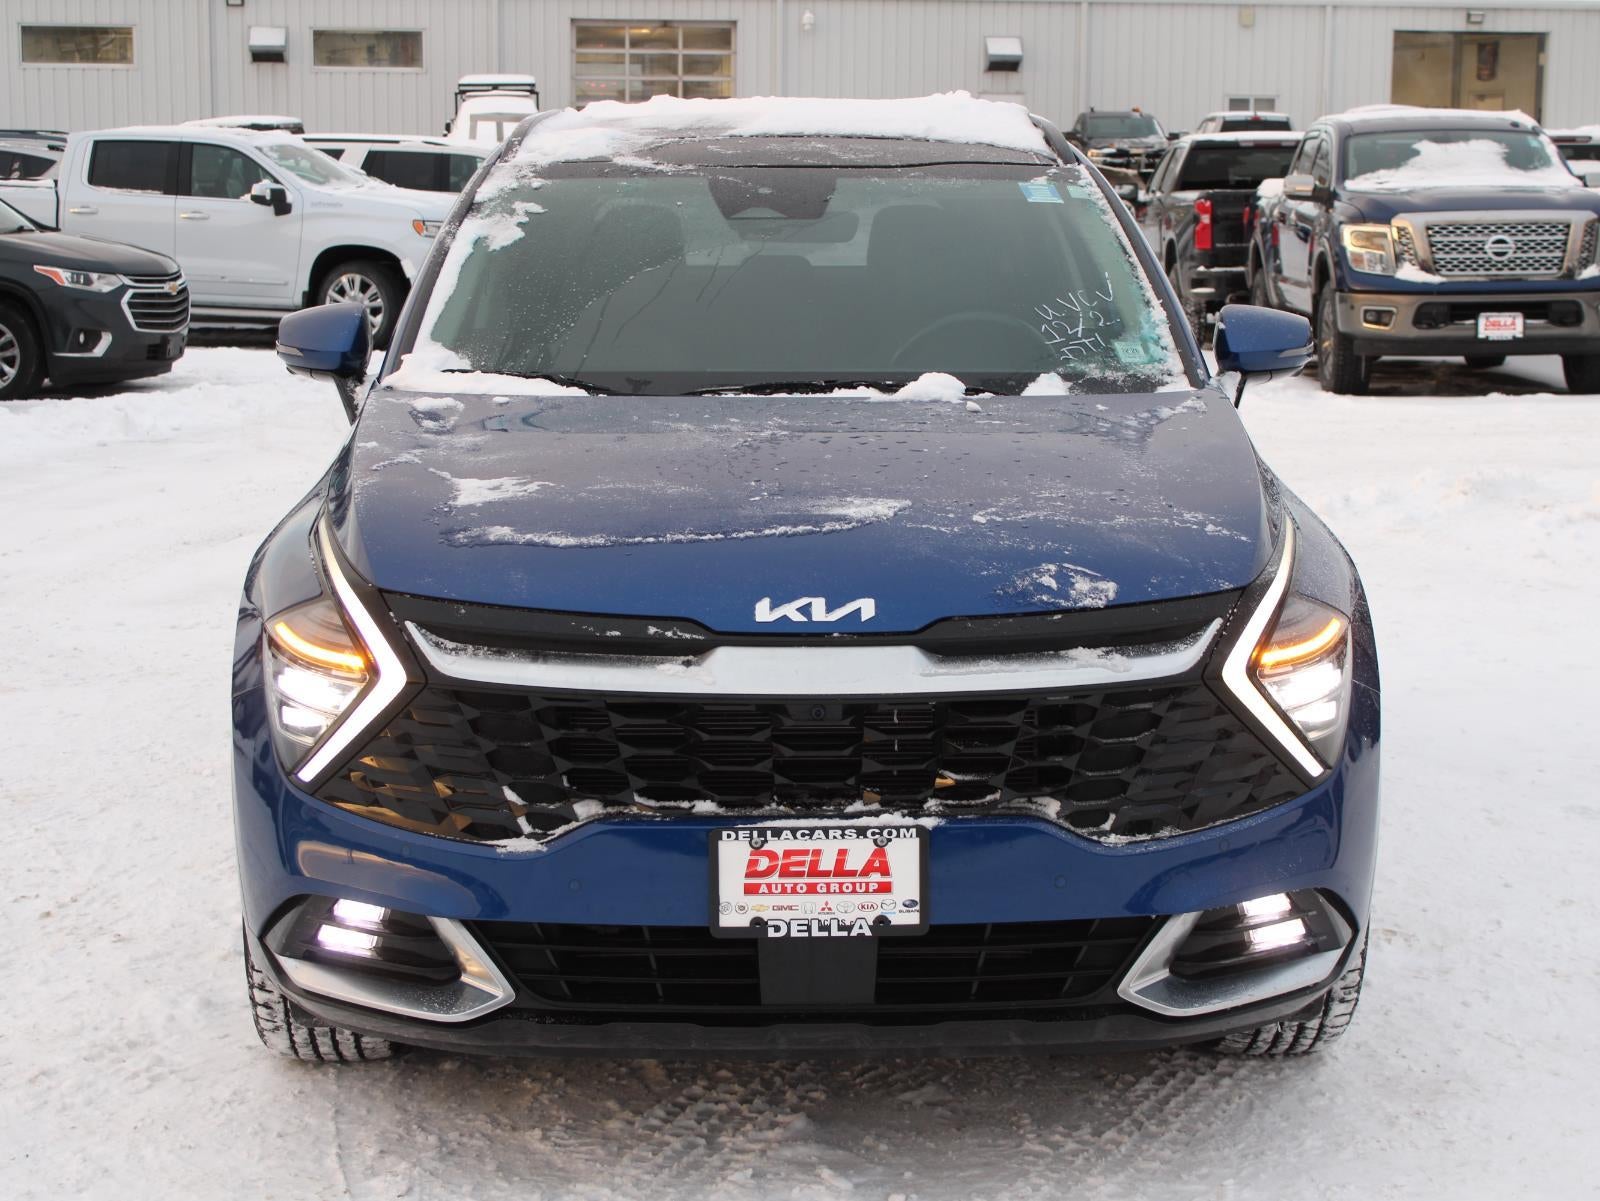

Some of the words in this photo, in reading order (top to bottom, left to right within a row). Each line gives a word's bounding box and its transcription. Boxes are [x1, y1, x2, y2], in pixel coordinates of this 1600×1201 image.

[755, 596, 876, 622] KIA
[721, 828, 917, 841] DELLACARS.COM
[744, 847, 893, 879] DELLA
[758, 882, 807, 895] AUTO
[816, 882, 879, 894] GROUP
[772, 904, 800, 912] GMC
[860, 903, 875, 911] KIA
[767, 918, 873, 938] DELLA
